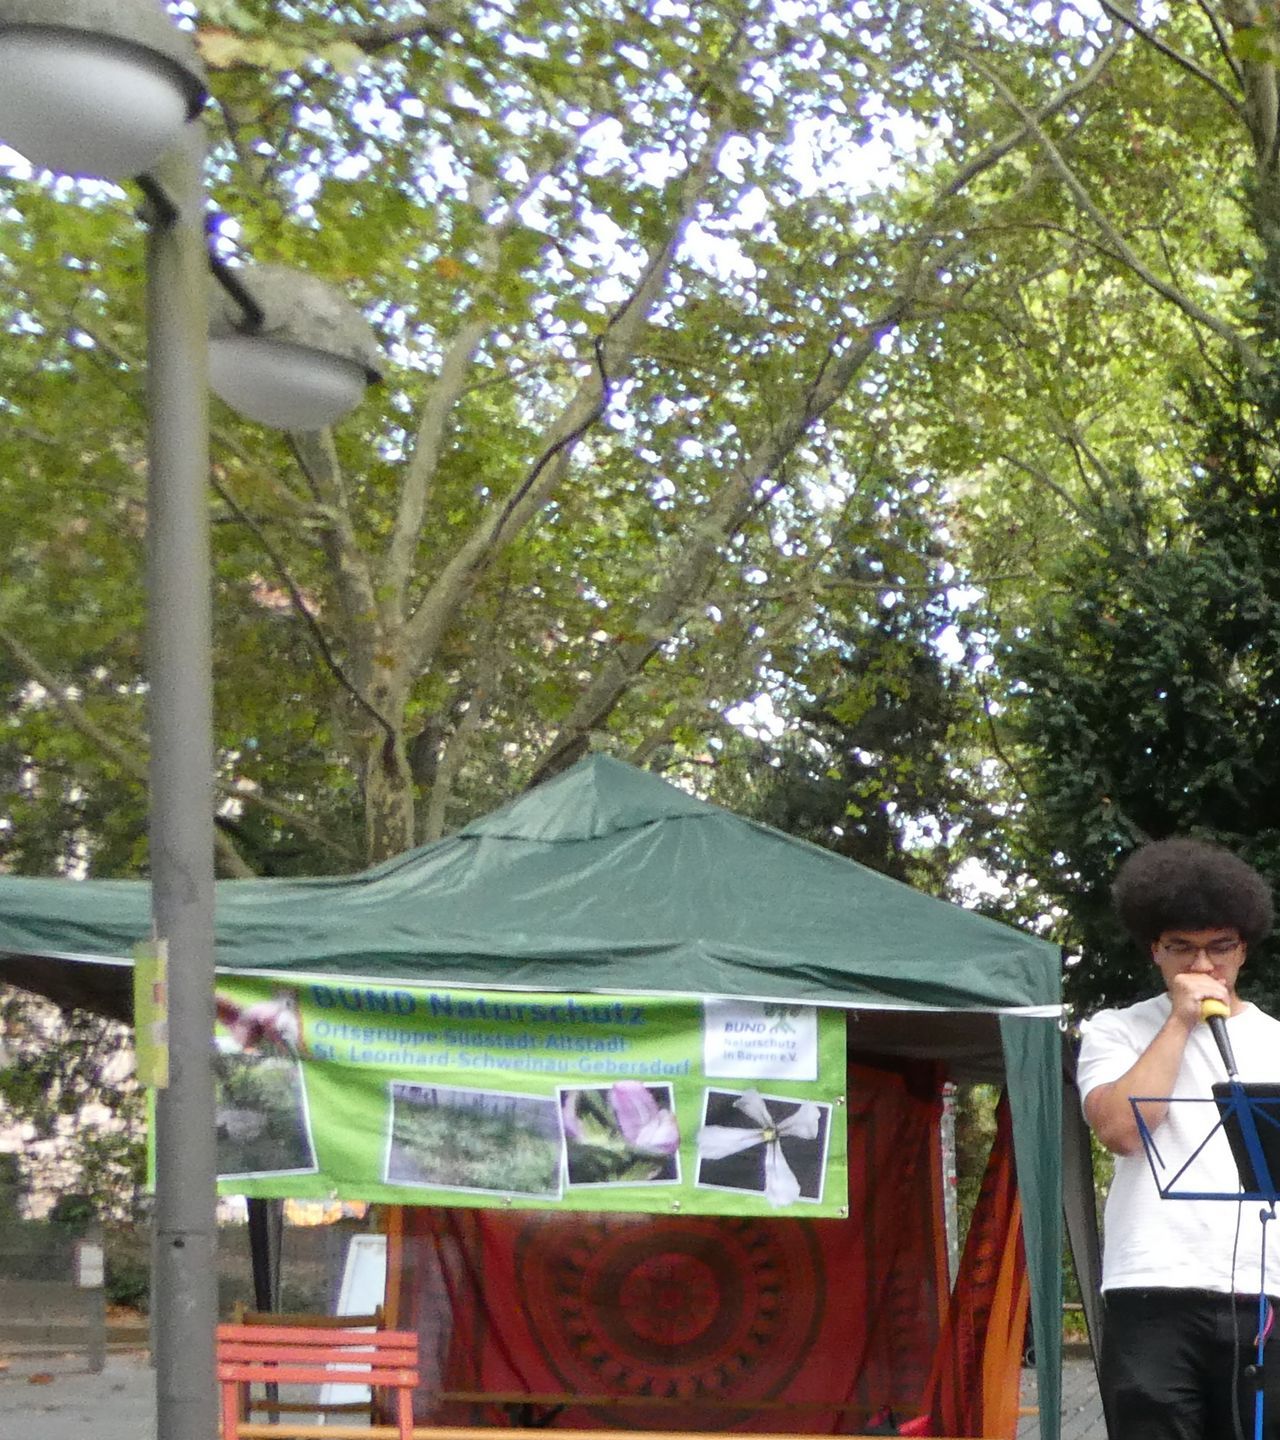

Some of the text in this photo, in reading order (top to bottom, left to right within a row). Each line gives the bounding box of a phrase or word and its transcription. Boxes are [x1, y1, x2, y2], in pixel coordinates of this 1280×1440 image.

[310, 984, 646, 1026] BUND Naturschutz
[724, 1021, 767, 1033] BUND
